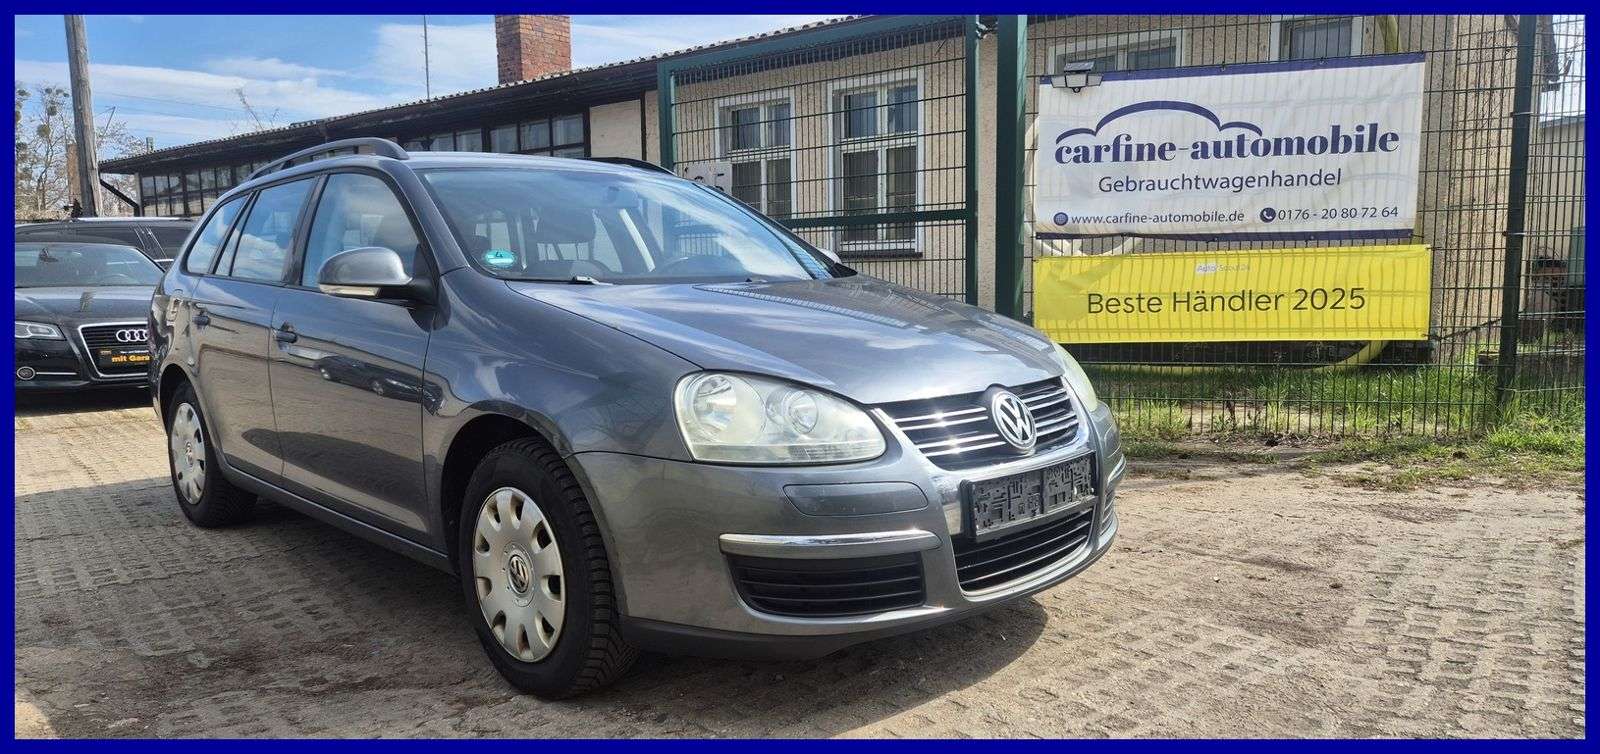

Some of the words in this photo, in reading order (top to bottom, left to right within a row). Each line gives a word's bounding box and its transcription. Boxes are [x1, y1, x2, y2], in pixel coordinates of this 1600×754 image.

[1054, 123, 1399, 165] carfine-automobile
[1098, 168, 1342, 193] Gebrauchtwagenhandel
[1071, 211, 1245, 224] www.carfine-automobile.de
[1278, 209, 1310, 220] 0176
[1321, 208, 1337, 219] 20
[1341, 207, 1357, 218] 80
[1361, 207, 1377, 218] 72
[1381, 206, 1398, 217] 64
[1087, 293, 1163, 314] Beste
[1173, 290, 1284, 313] Händler
[1292, 287, 1366, 311] 2025
